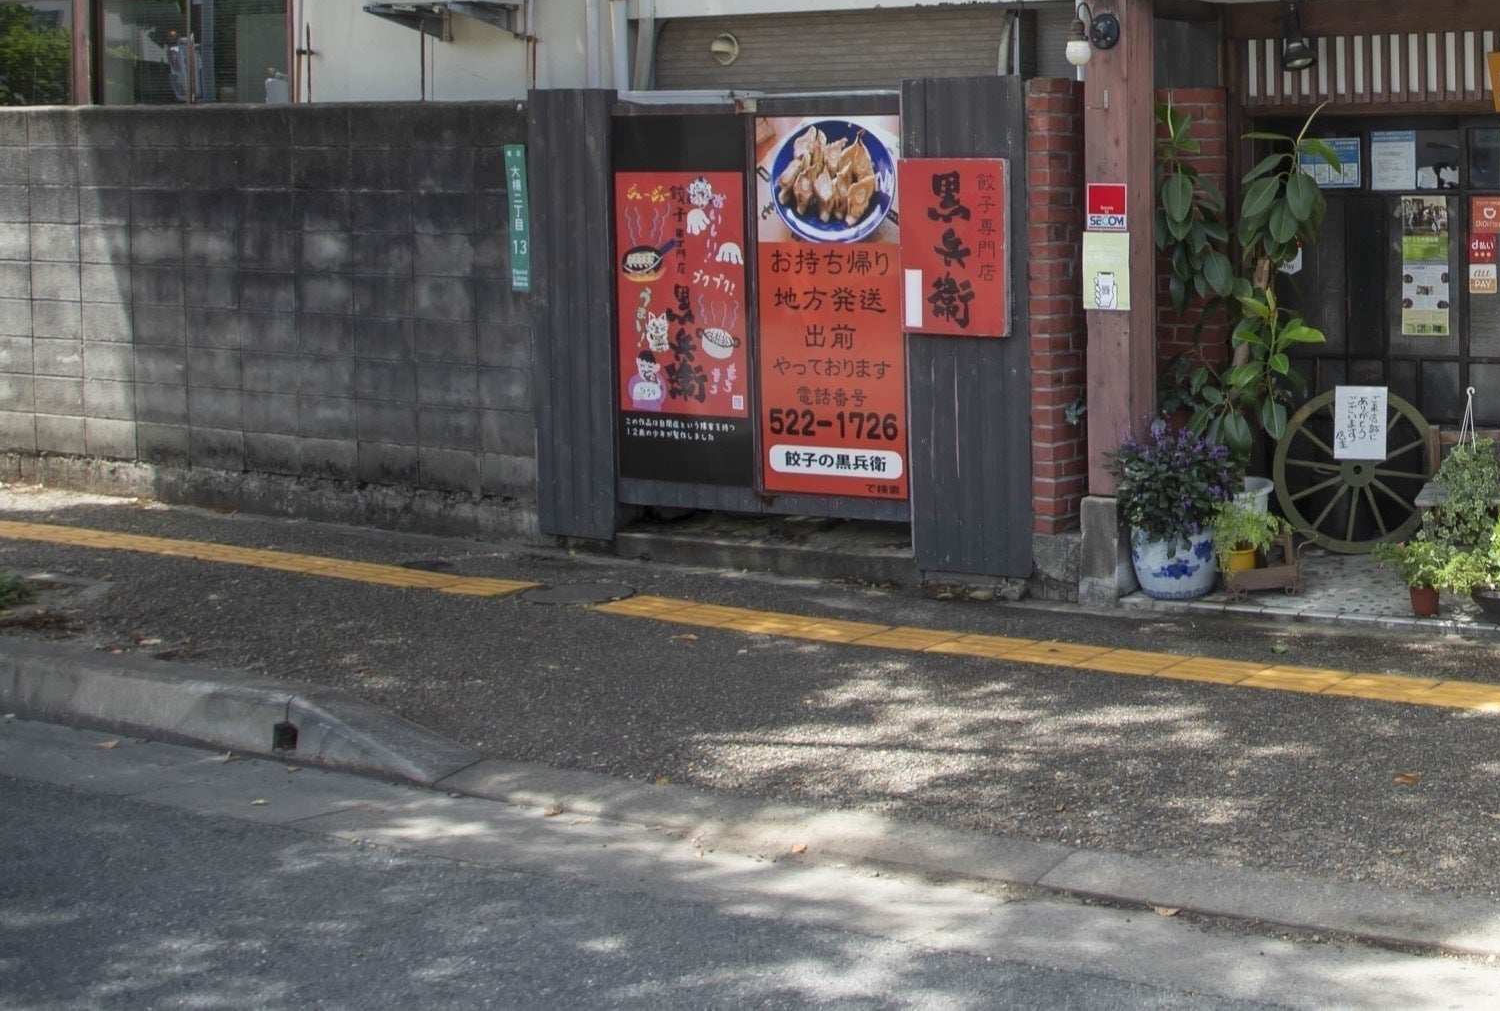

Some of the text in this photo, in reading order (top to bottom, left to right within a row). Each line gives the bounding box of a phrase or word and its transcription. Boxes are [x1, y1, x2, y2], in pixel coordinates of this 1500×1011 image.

[976, 173, 996, 282] 餃子専門店
[1089, 216, 1124, 226] SECOM
[512, 239, 527, 255] 13
[927, 170, 975, 329] 黒兵衛
[1471, 239, 1494, 250] d払い
[771, 249, 889, 276] お持ち帰り
[1474, 269, 1491, 277] au
[1475, 280, 1492, 288] PAY
[774, 286, 887, 313] 地方発送
[664, 284, 708, 403] 黒兵衛
[805, 324, 856, 350] 出前
[773, 356, 891, 378] やっております
[797, 386, 867, 407] 電話番号
[769, 407, 899, 441] 522-1726
[1347, 395, 1357, 442] ございます
[1358, 396, 1369, 440] ありがとう
[785, 450, 887, 472] 餃子の黒兵衛
